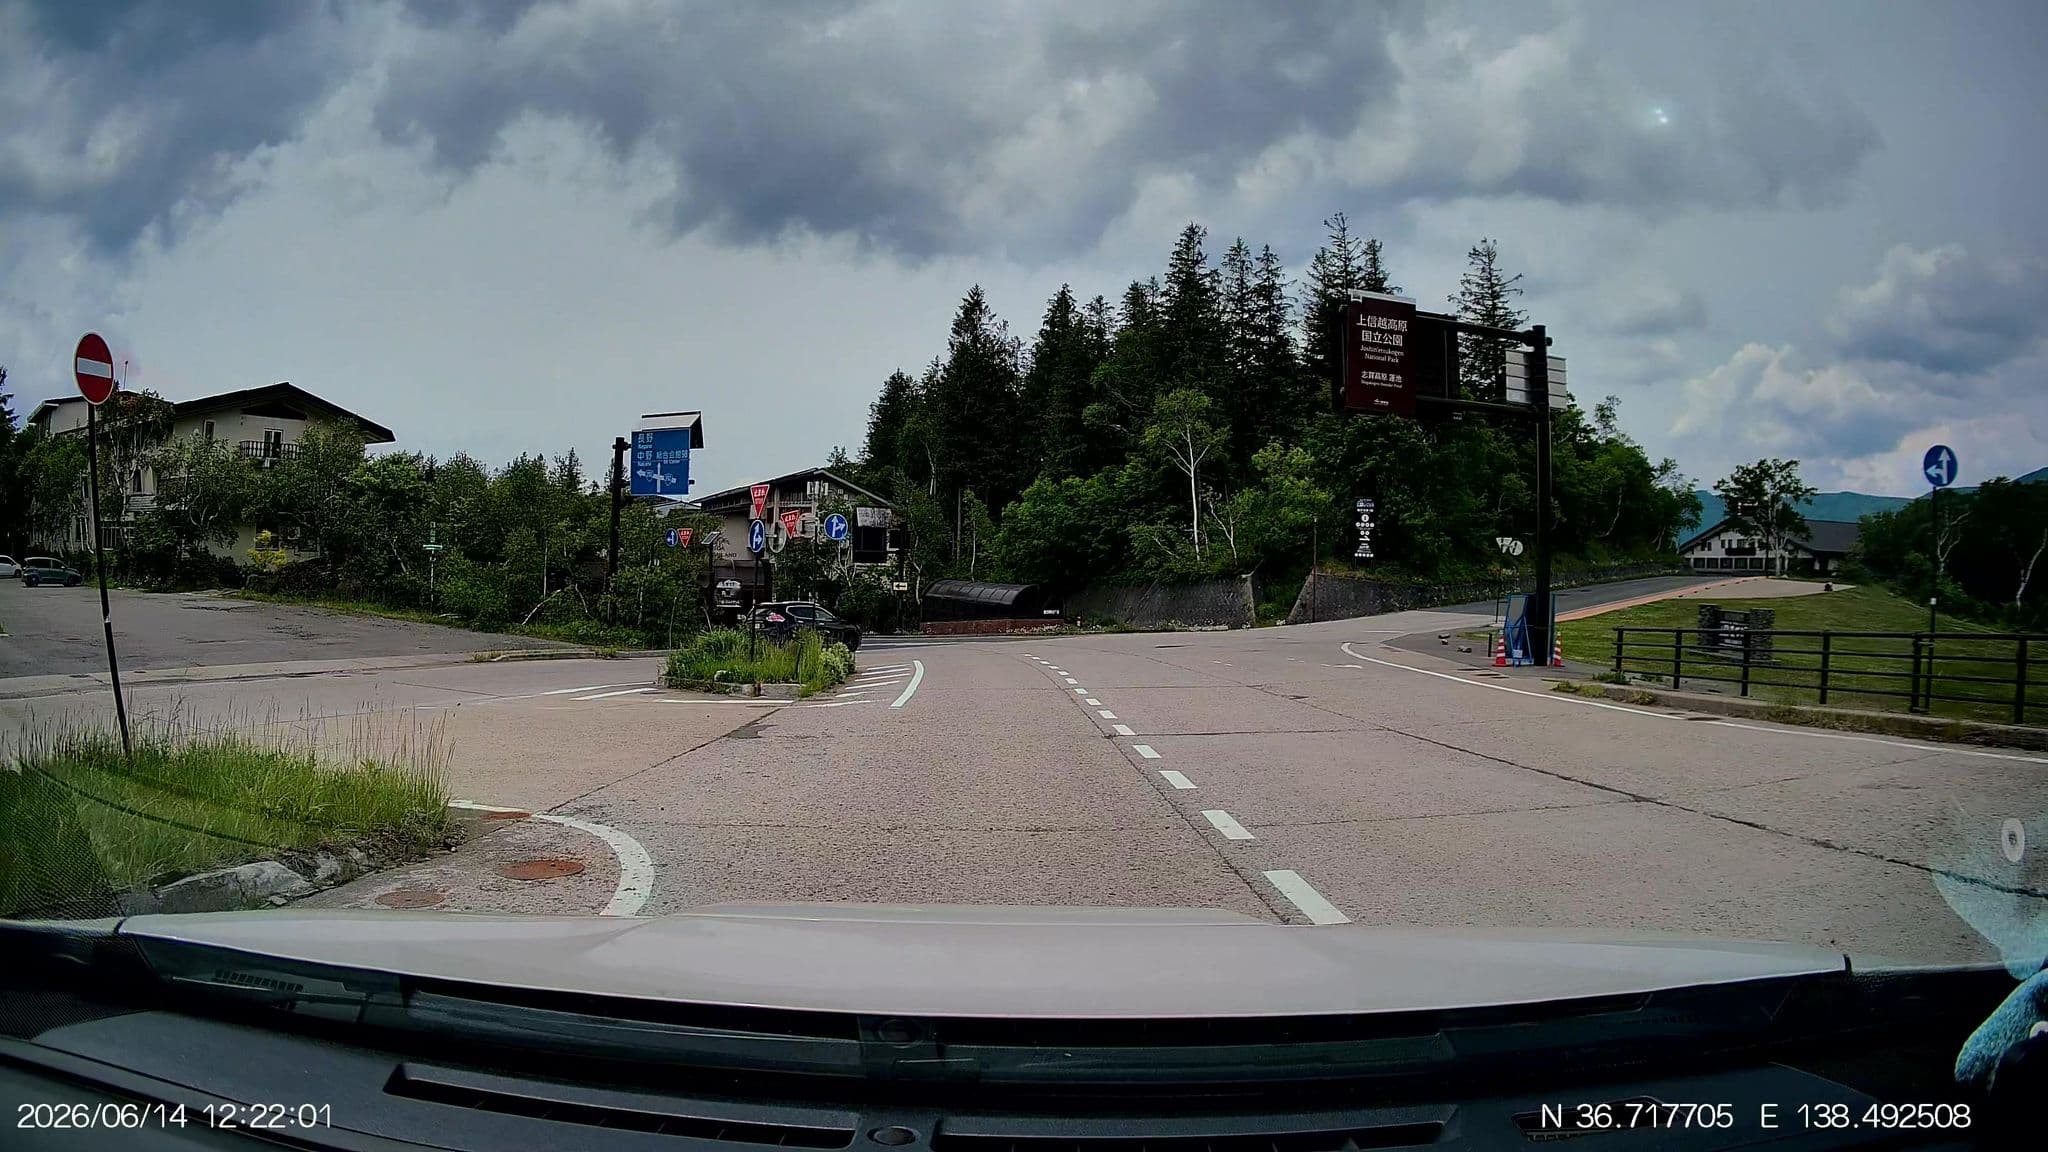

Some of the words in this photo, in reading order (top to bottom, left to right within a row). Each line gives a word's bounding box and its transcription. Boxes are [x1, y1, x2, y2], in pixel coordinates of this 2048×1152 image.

[1356, 314, 1408, 332] 上信越高原
[1361, 330, 1403, 347] 国立公園
[1365, 353, 1387, 361] National
[1387, 355, 1399, 363] Park
